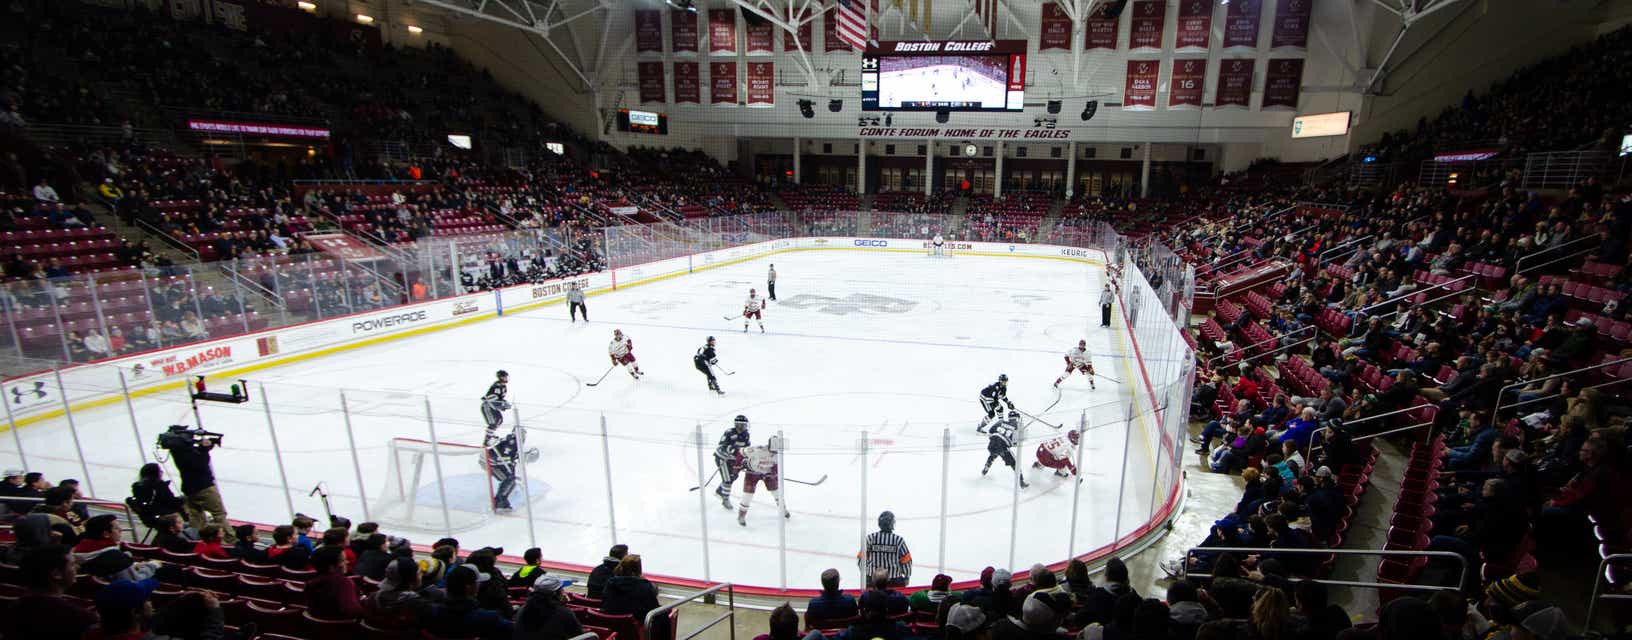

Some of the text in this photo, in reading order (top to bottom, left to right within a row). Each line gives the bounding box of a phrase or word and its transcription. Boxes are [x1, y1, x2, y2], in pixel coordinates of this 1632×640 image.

[894, 41, 992, 52] BOSTON COLLEGE
[1181, 80, 1194, 89] 16
[631, 114, 656, 122] GEICO
[859, 127, 1071, 139] CONTE FORUM HOME OF THE EAGLES
[854, 239, 888, 247] GEICO
[1061, 248, 1089, 257] KEURIG
[532, 278, 590, 299] BOSTON COEGE
[352, 310, 427, 334] POWERADE
